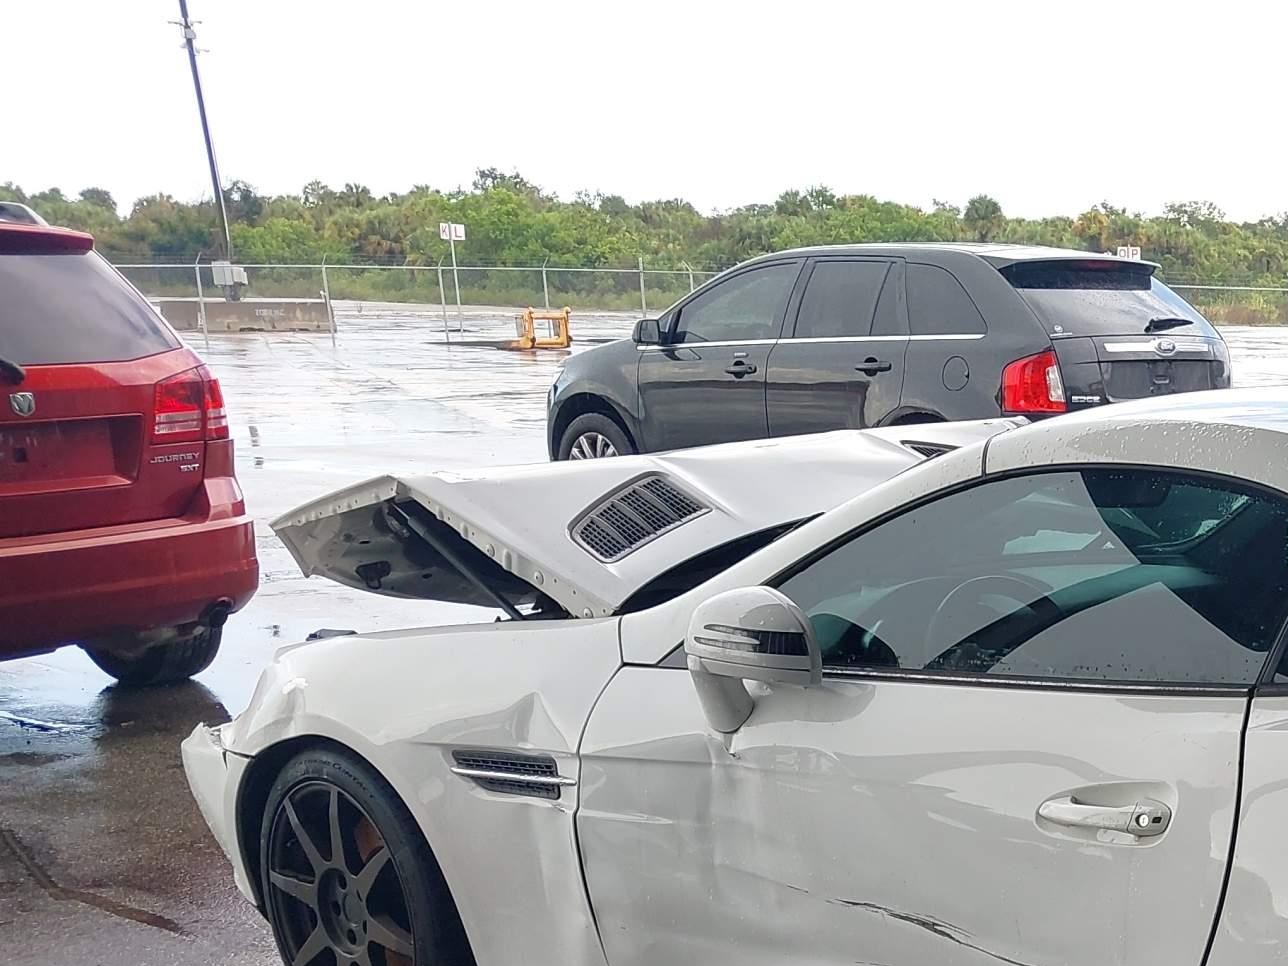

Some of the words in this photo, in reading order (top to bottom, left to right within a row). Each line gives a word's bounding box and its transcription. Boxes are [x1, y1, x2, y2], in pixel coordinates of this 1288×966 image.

[441, 224, 448, 238] K
[454, 225, 463, 238] L
[1131, 248, 1139, 259] P
[150, 452, 200, 464] JOURNEY
[180, 463, 200, 472] SXT
